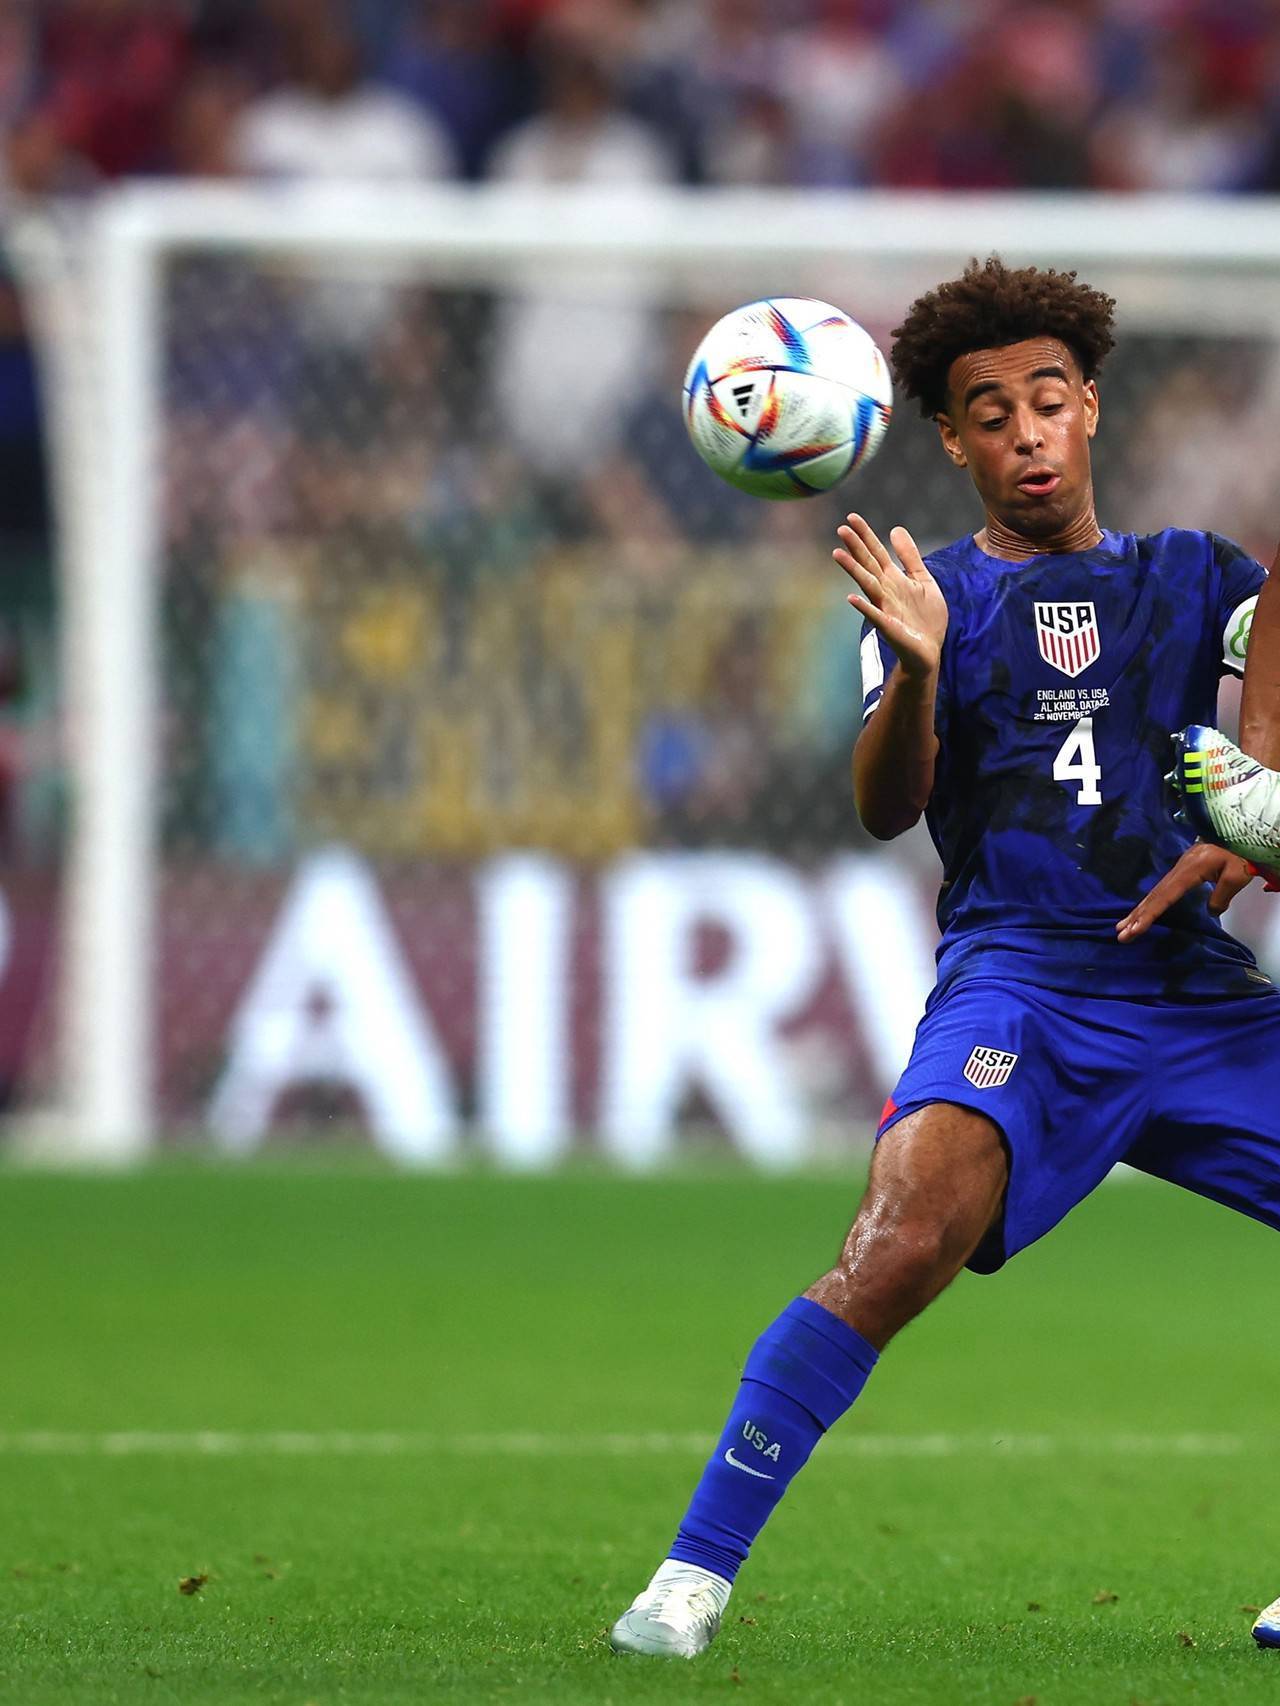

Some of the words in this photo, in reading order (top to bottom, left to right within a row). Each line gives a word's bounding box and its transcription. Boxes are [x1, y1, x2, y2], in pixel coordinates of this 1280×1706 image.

[1038, 606, 1092, 634] USA
[1037, 689, 1075, 701] ENGLAND
[1077, 689, 1090, 700] VS.
[1091, 688, 1108, 699] USA
[1041, 702, 1052, 712] AL
[1053, 717, 1102, 805] 4
[974, 1048, 1015, 1067] USA
[743, 1420, 781, 1462] USA
